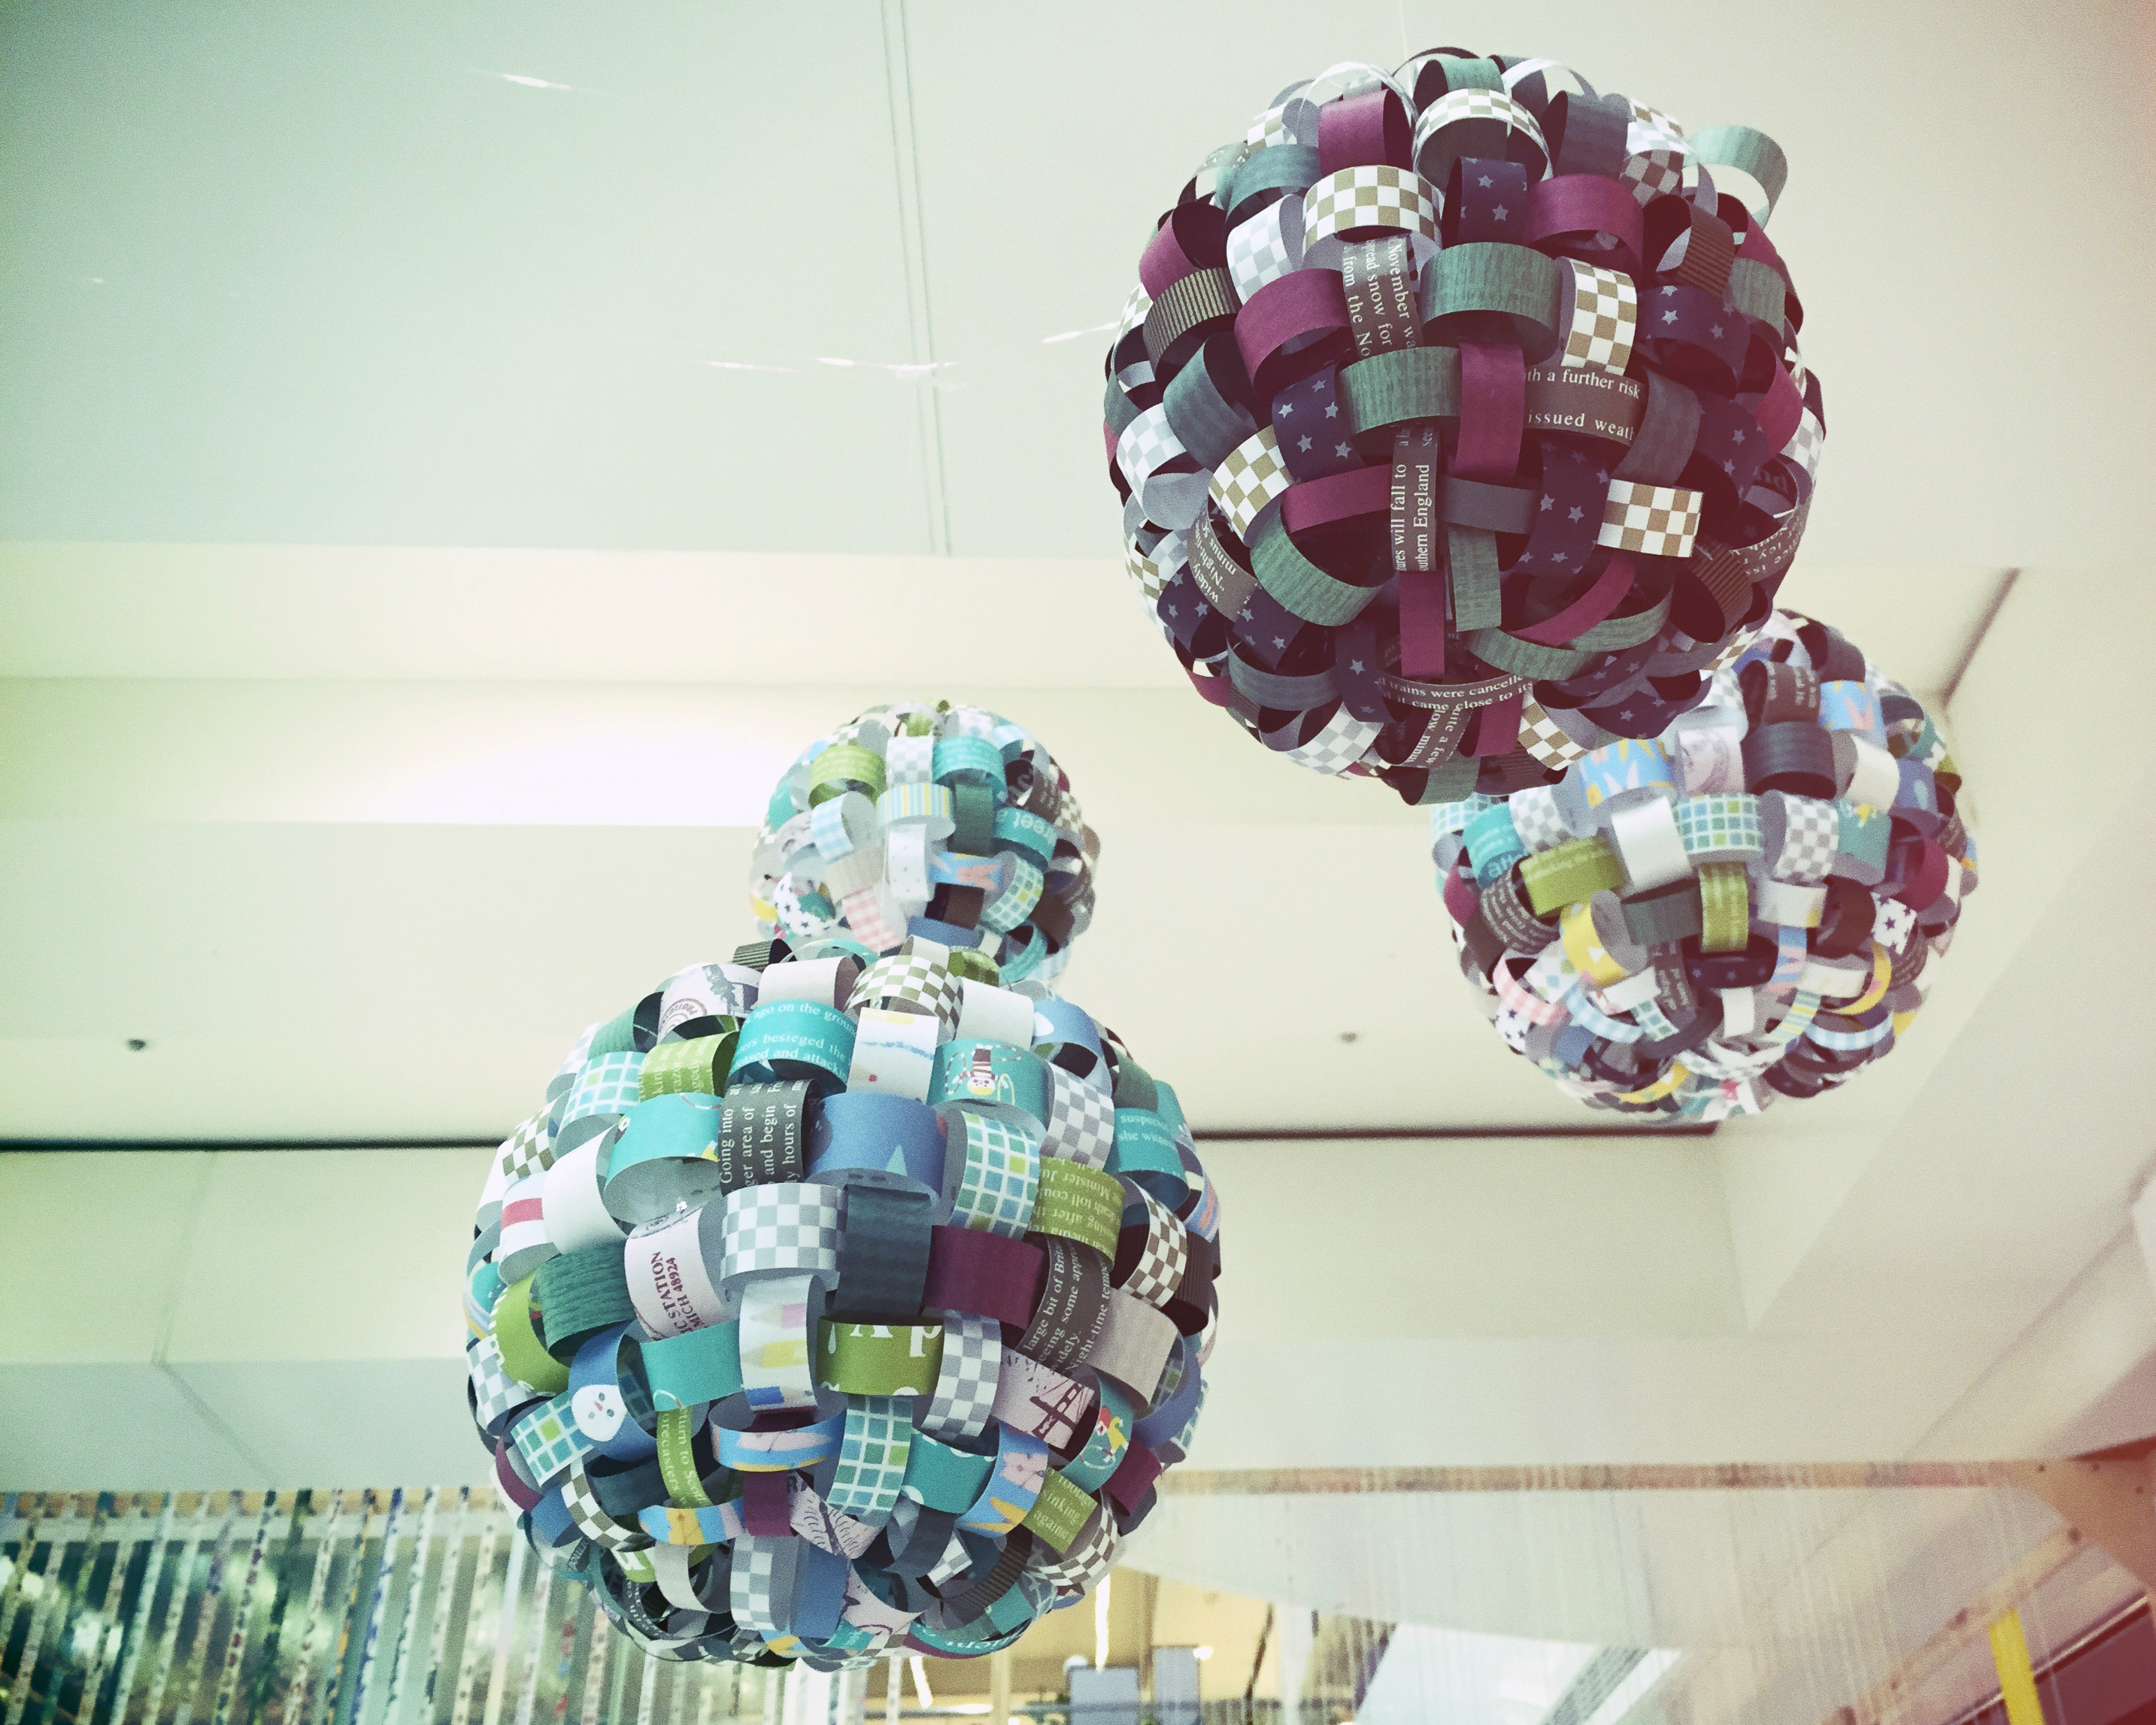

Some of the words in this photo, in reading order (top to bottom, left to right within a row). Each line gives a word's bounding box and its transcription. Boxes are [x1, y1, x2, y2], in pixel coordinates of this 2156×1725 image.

[1342, 256, 1357, 287] from
[1388, 243, 1410, 319] November
[1348, 295, 1364, 323] the
[1367, 274, 1385, 315] snow
[1378, 323, 1393, 345] for
[1547, 371, 1556, 382] a
[1562, 368, 1615, 390] further
[1618, 380, 1640, 399] risk
[1527, 409, 1585, 427] issued
[1393, 464, 1407, 479] to
[1390, 485, 1405, 511] fall
[1413, 464, 1433, 528] England
[1390, 518, 1405, 545] will
[1390, 680, 1427, 696] trains
[1430, 688, 1466, 698] were
[1412, 700, 1450, 711] came
[1455, 697, 1493, 710] close
[1499, 692, 1514, 702] to
[778, 1004, 795, 1012] on
[799, 1002, 821, 1015] the
[763, 1033, 825, 1050] besieged
[773, 1047, 799, 1059] and
[718, 1108, 734, 1134] into
[741, 1106, 756, 1120] of
[783, 1103, 797, 1118] of
[760, 1105, 778, 1144] begin
[741, 1126, 753, 1157] area
[782, 1123, 796, 1165] hours
[718, 1138, 735, 1184] Going
[760, 1149, 775, 1175] and
[650, 1251, 681, 1319] STATION
[1023, 1319, 1049, 1351] large
[1043, 1296, 1059, 1316] bit
[1054, 1275, 1064, 1293] of
[1061, 1286, 1078, 1324] some
[679, 1451, 690, 1466] to
